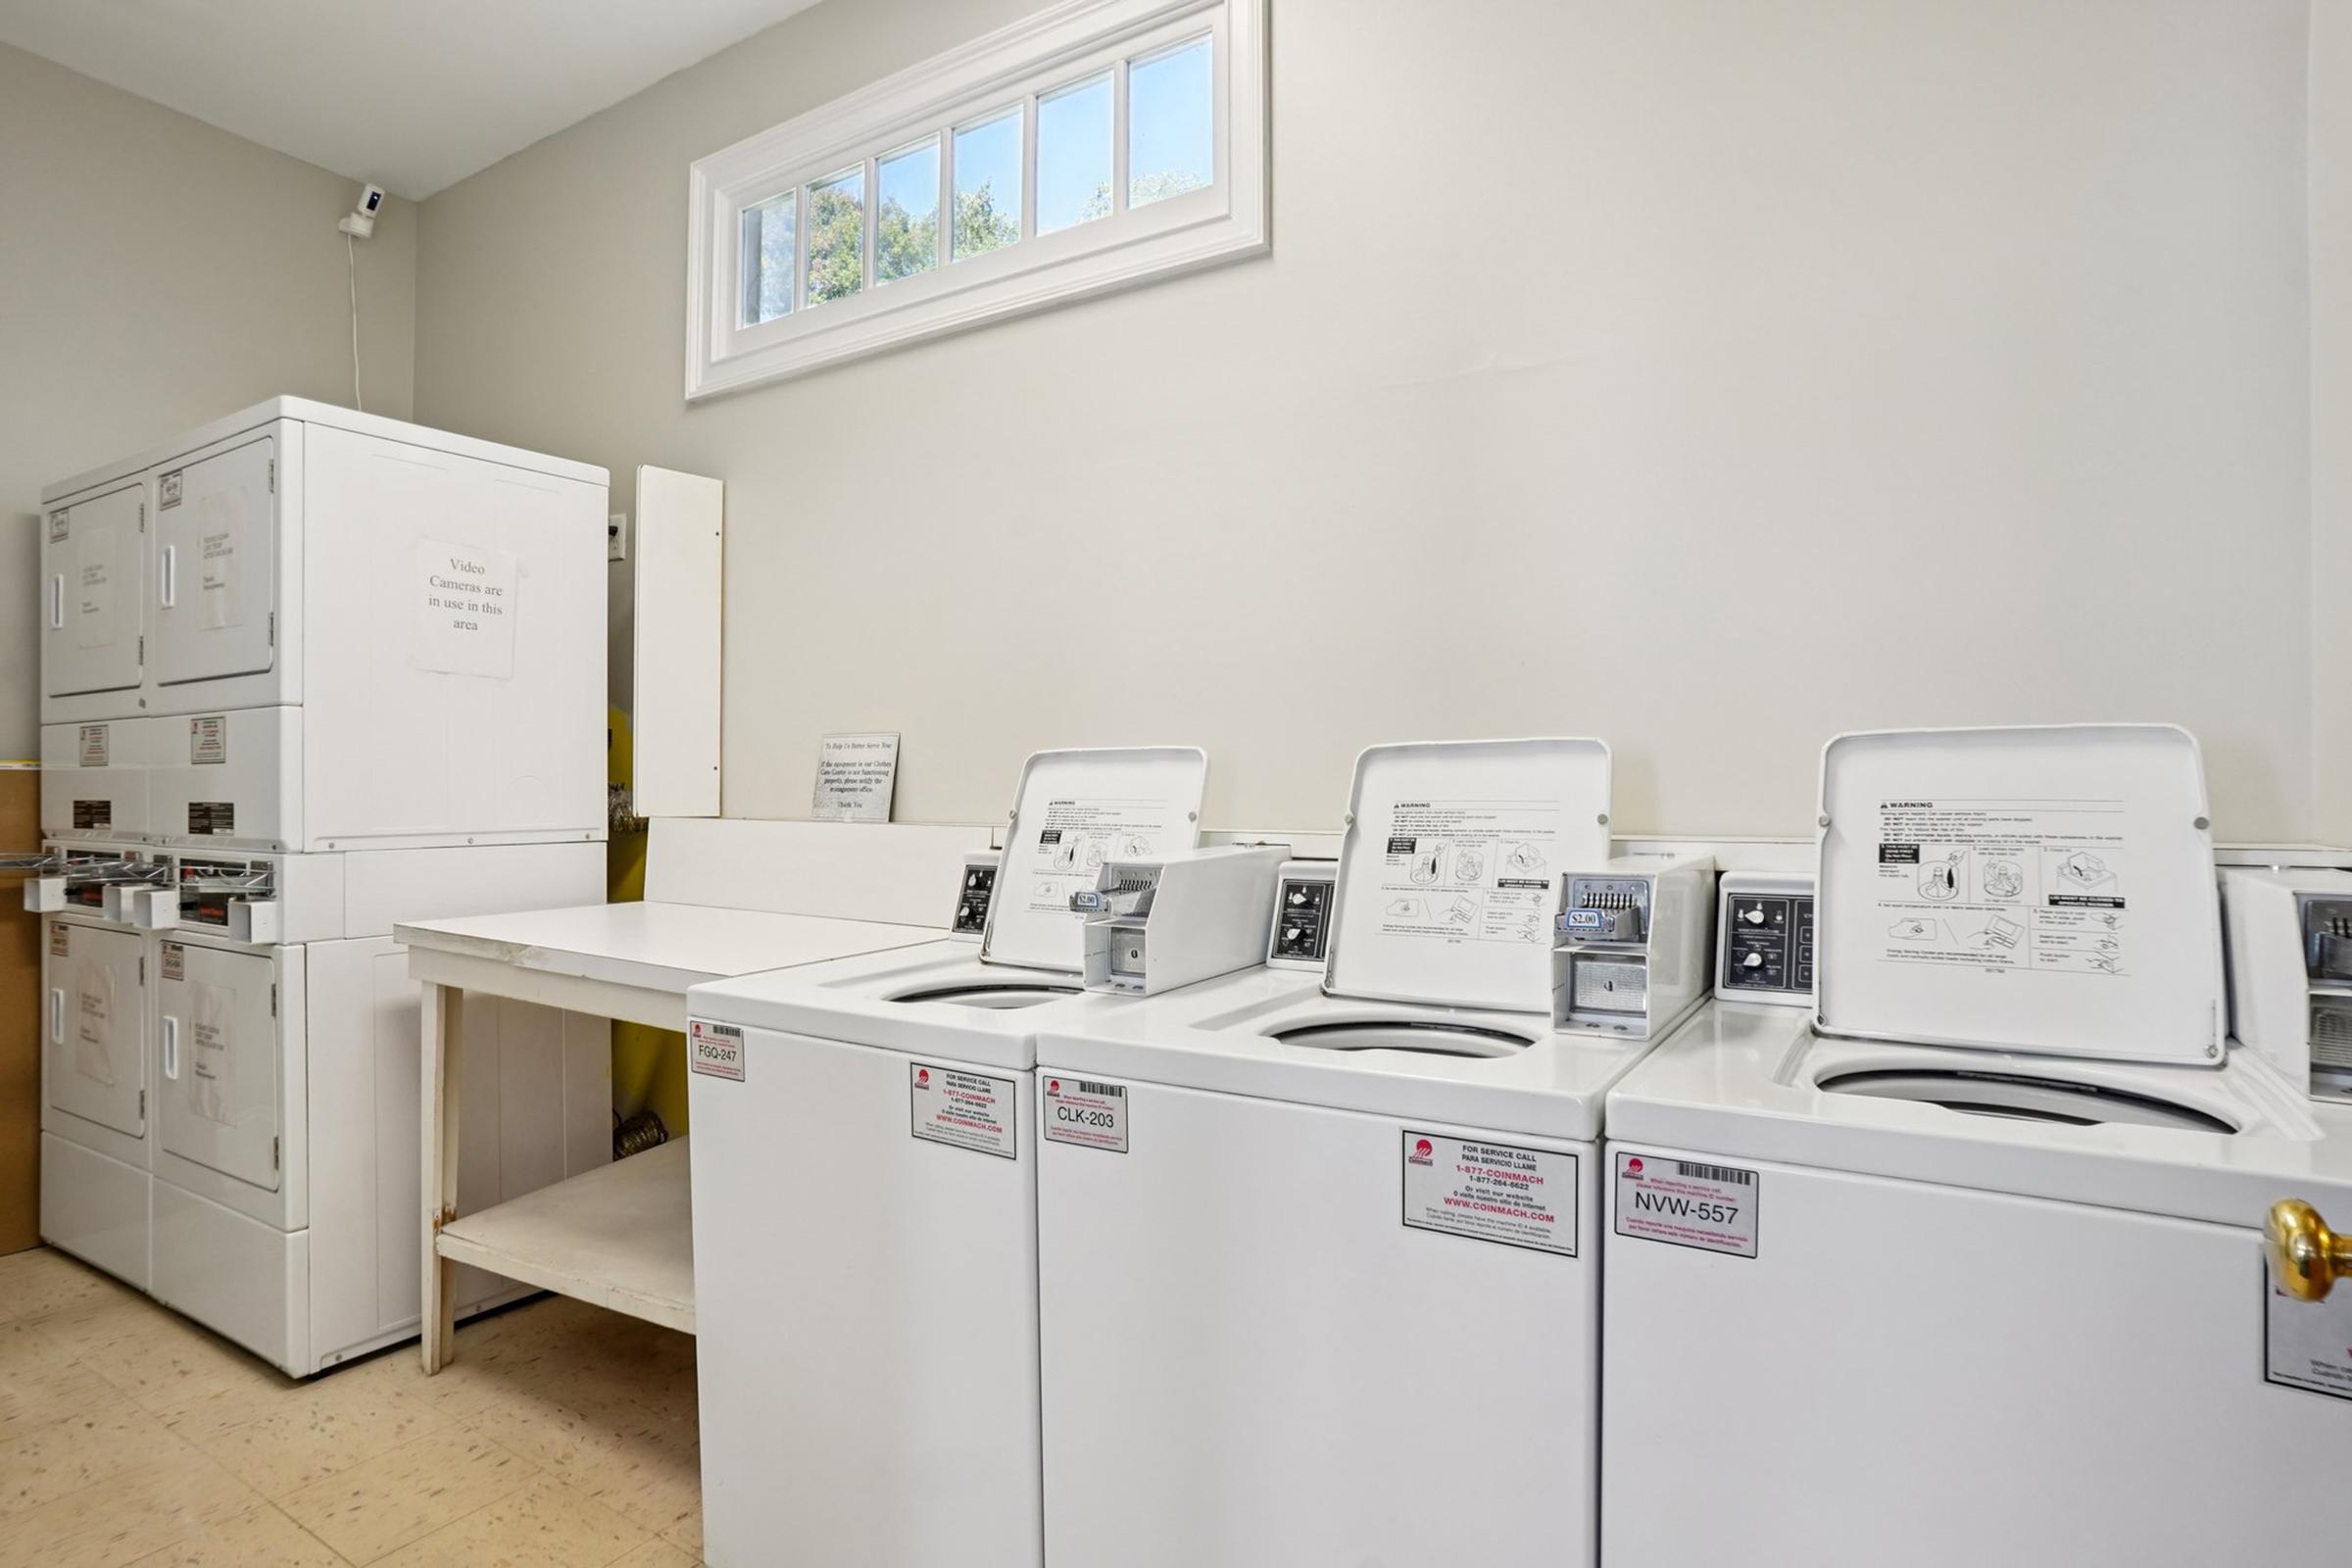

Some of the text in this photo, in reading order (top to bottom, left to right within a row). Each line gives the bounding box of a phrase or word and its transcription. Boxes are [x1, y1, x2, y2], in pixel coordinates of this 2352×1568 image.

[450, 558, 485, 574] Video
[429, 575, 503, 596] Cameras are
[428, 594, 503, 614] in use in this
[453, 619, 477, 630] area
[1079, 895, 1096, 904] $2.00
[1572, 911, 1596, 924] $2.00
[956, 1075, 977, 1084] SERVICE
[1057, 1106, 1114, 1128] CLK-203
[1462, 1145, 1537, 1162] FOR SERVICE CALL
[1481, 1156, 1512, 1168] SERVICIO
[1514, 1162, 1537, 1172] LLAME
[1455, 1164, 1544, 1185] 1-877-COINMACH
[1475, 1187, 1491, 1196] visit
[1505, 1192, 1534, 1202] website
[1443, 1197, 1554, 1223] WWW.COINMACH.COM
[1635, 1191, 1739, 1224] NVW-557
